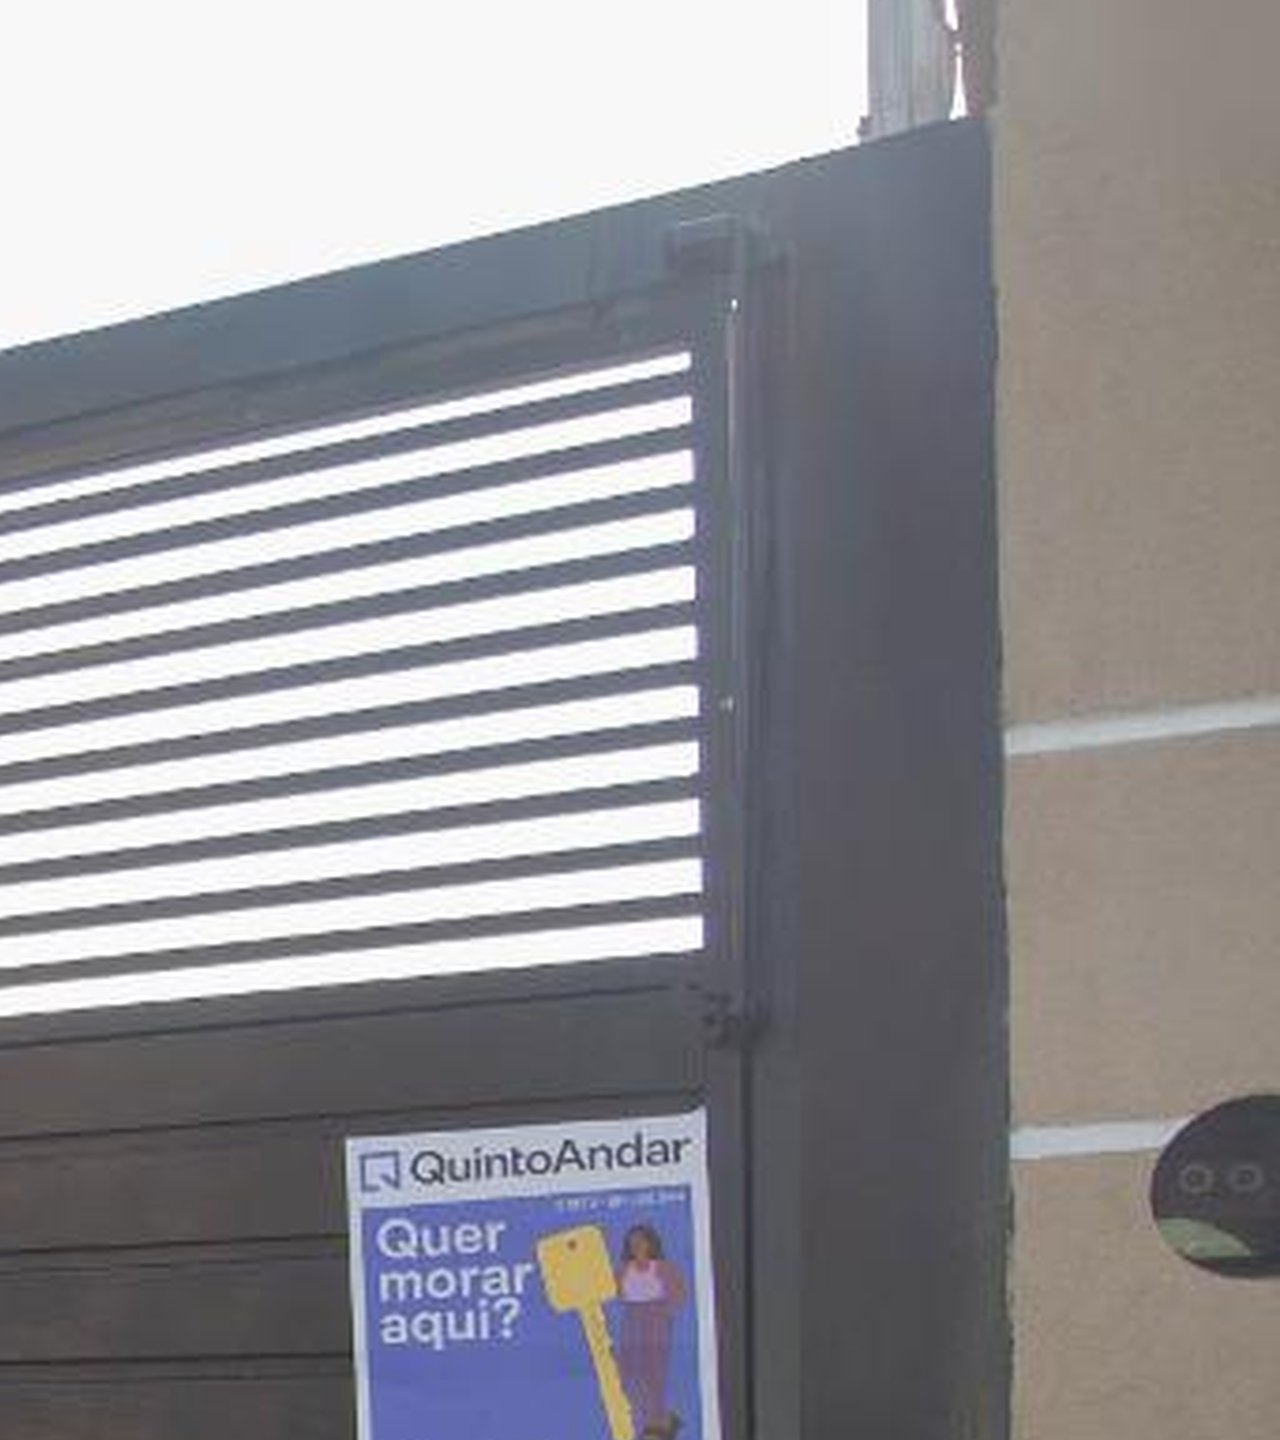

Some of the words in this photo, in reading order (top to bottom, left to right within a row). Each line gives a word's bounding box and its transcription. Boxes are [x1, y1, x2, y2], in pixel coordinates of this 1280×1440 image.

[410, 1133, 692, 1186] QuintoAndar
[375, 1218, 506, 1259] Quer
[379, 1262, 534, 1303] morar
[380, 1297, 520, 1351] aqui?
